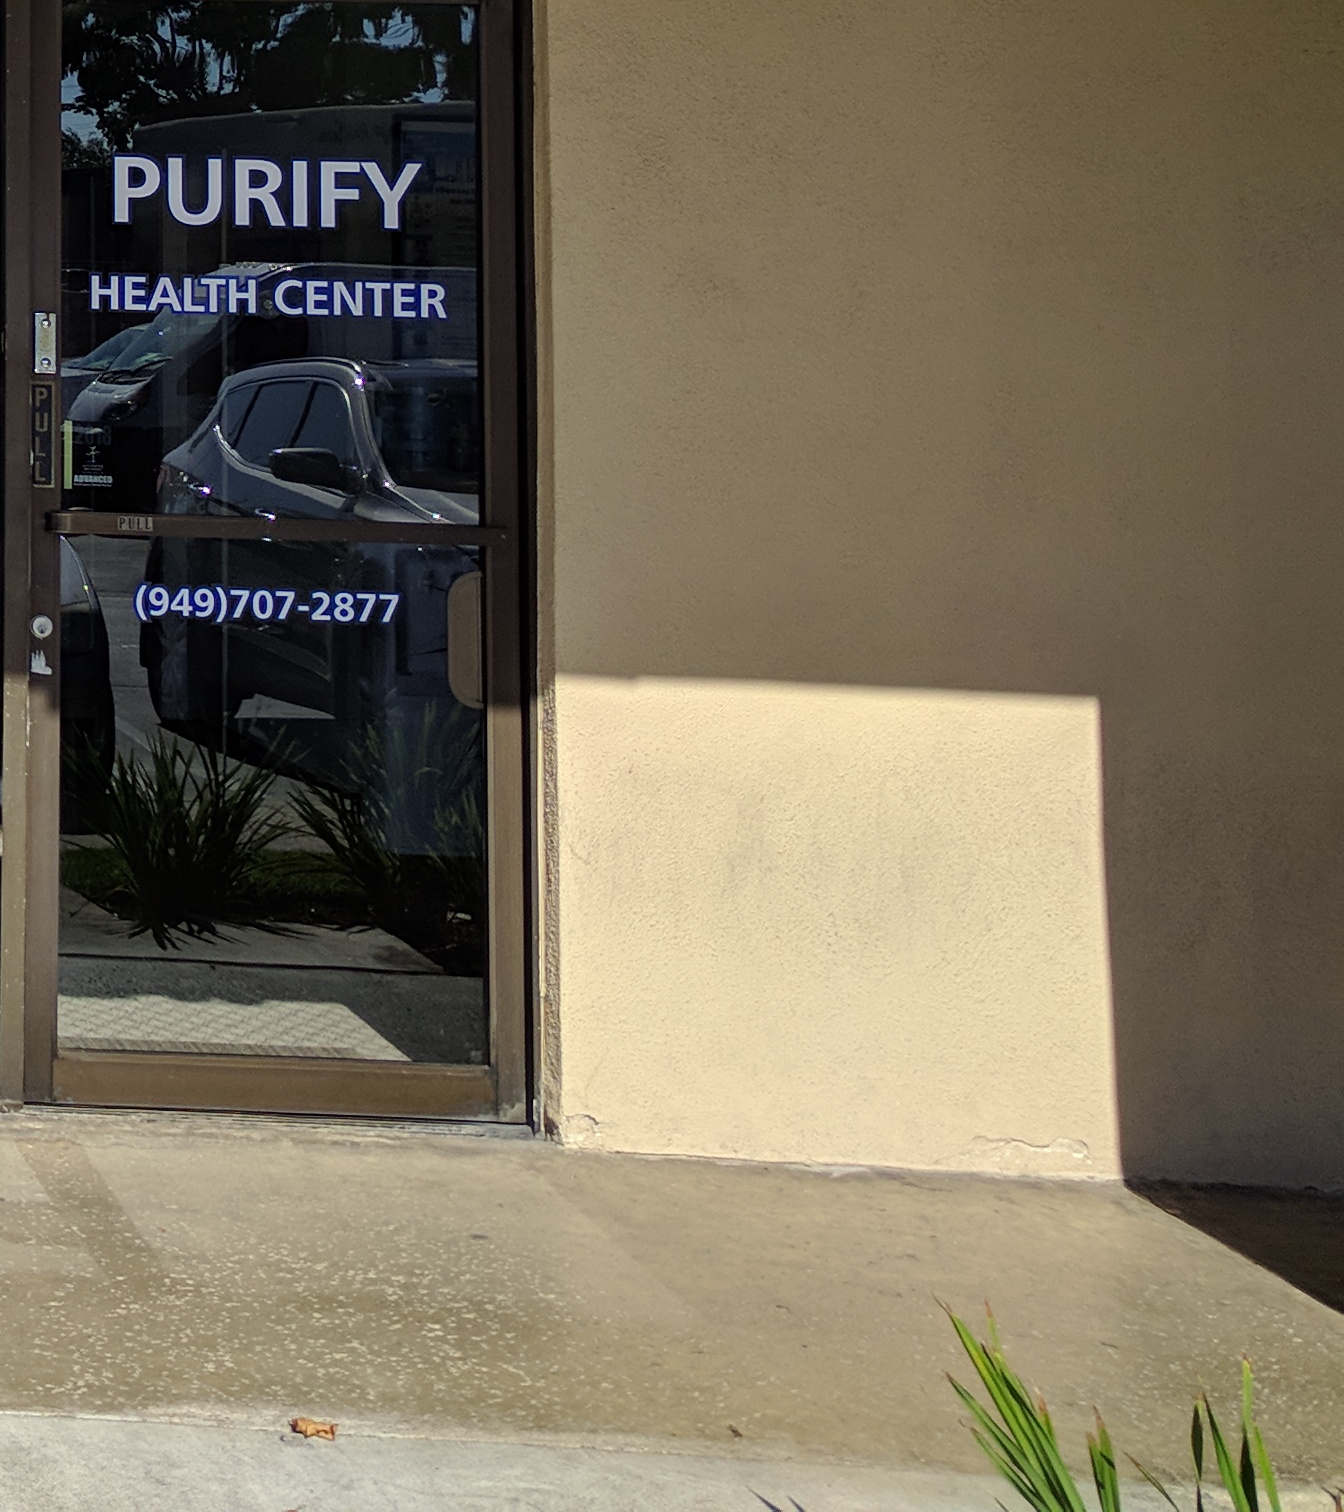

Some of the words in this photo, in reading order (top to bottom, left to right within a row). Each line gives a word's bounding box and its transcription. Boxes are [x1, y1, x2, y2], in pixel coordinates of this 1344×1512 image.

[112, 154, 423, 230] PURIFY
[89, 274, 258, 315] HEALTH
[273, 278, 448, 320] CENTER
[35, 388, 48, 481] PULL
[118, 515, 153, 531] PULL
[134, 584, 400, 624] (949)707-2877
